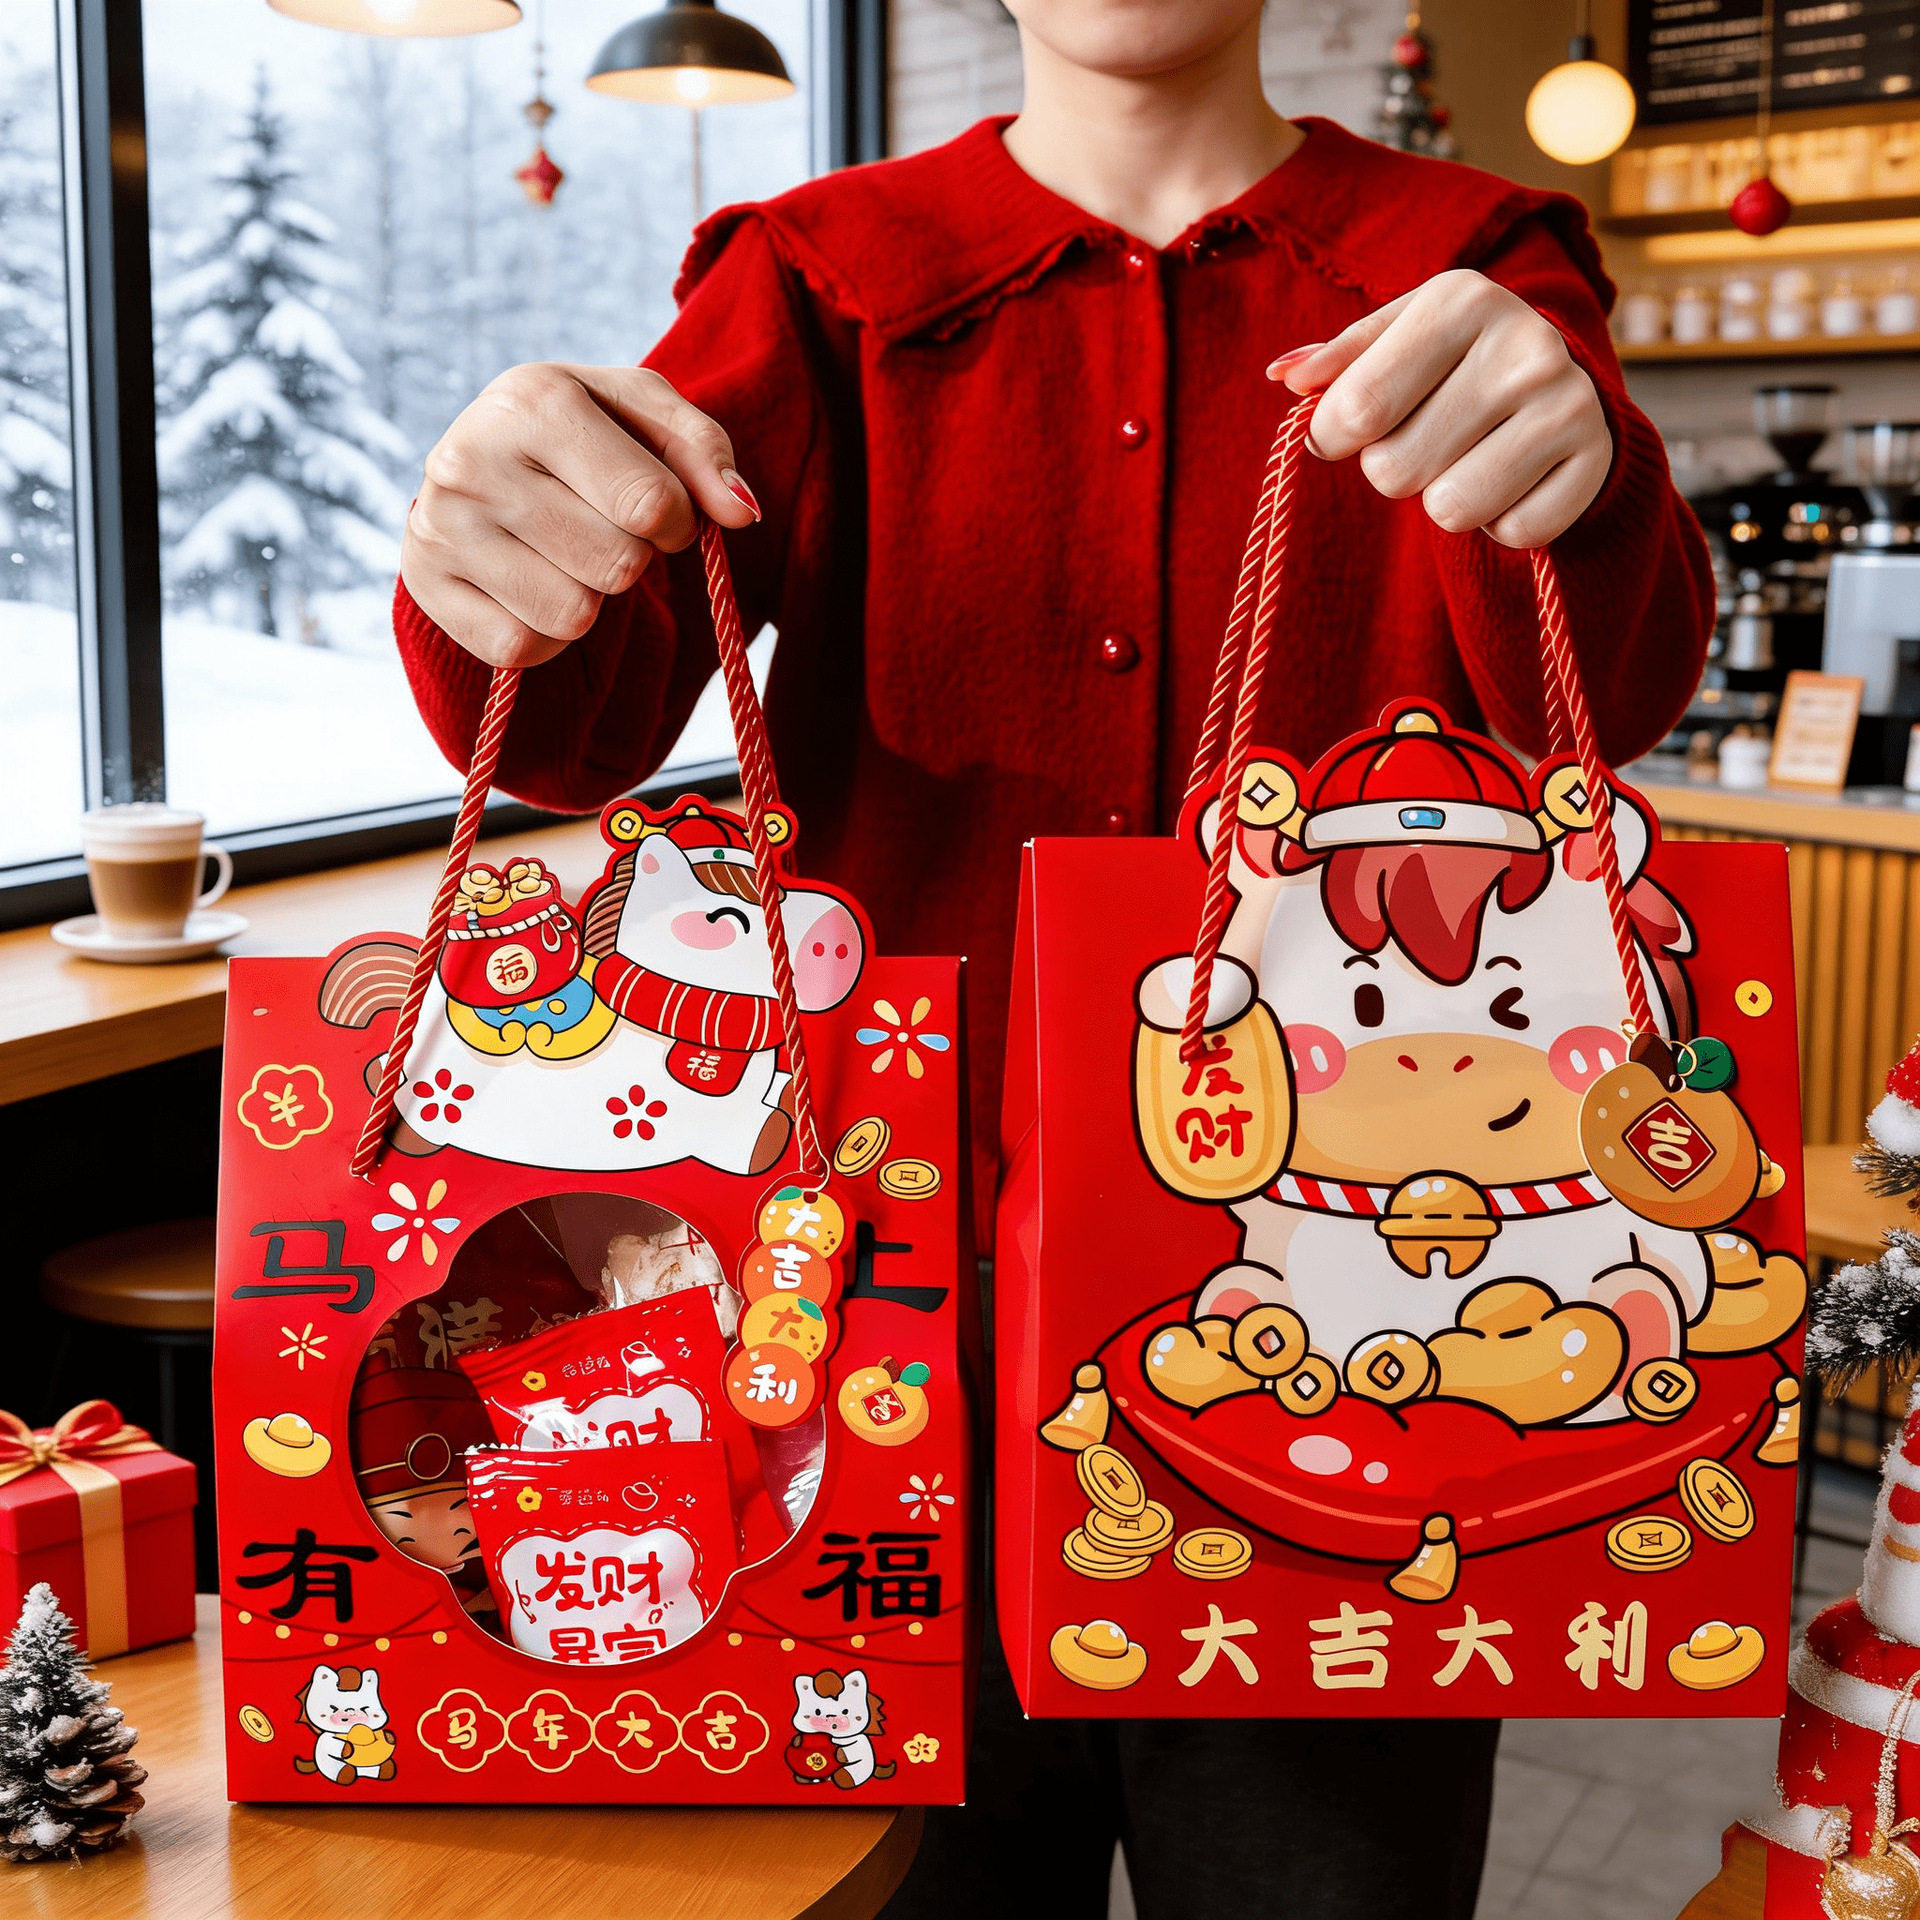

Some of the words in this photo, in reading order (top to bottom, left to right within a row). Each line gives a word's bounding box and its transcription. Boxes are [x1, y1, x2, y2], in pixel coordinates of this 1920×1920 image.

[493, 953, 529, 986] 福
[686, 1050, 721, 1081] 福
[1646, 1117, 1692, 1171] 吉
[232, 1219, 376, 1314] 马
[842, 1220, 949, 1313] 上
[746, 1204, 822, 1404] 大吉大利
[236, 1528, 379, 1623] 有
[802, 1532, 941, 1622] 福
[535, 1551, 665, 1612] 发财
[1177, 1601, 1648, 1691] 大吉大利
[447, 1708, 738, 1751] 马年大吉
